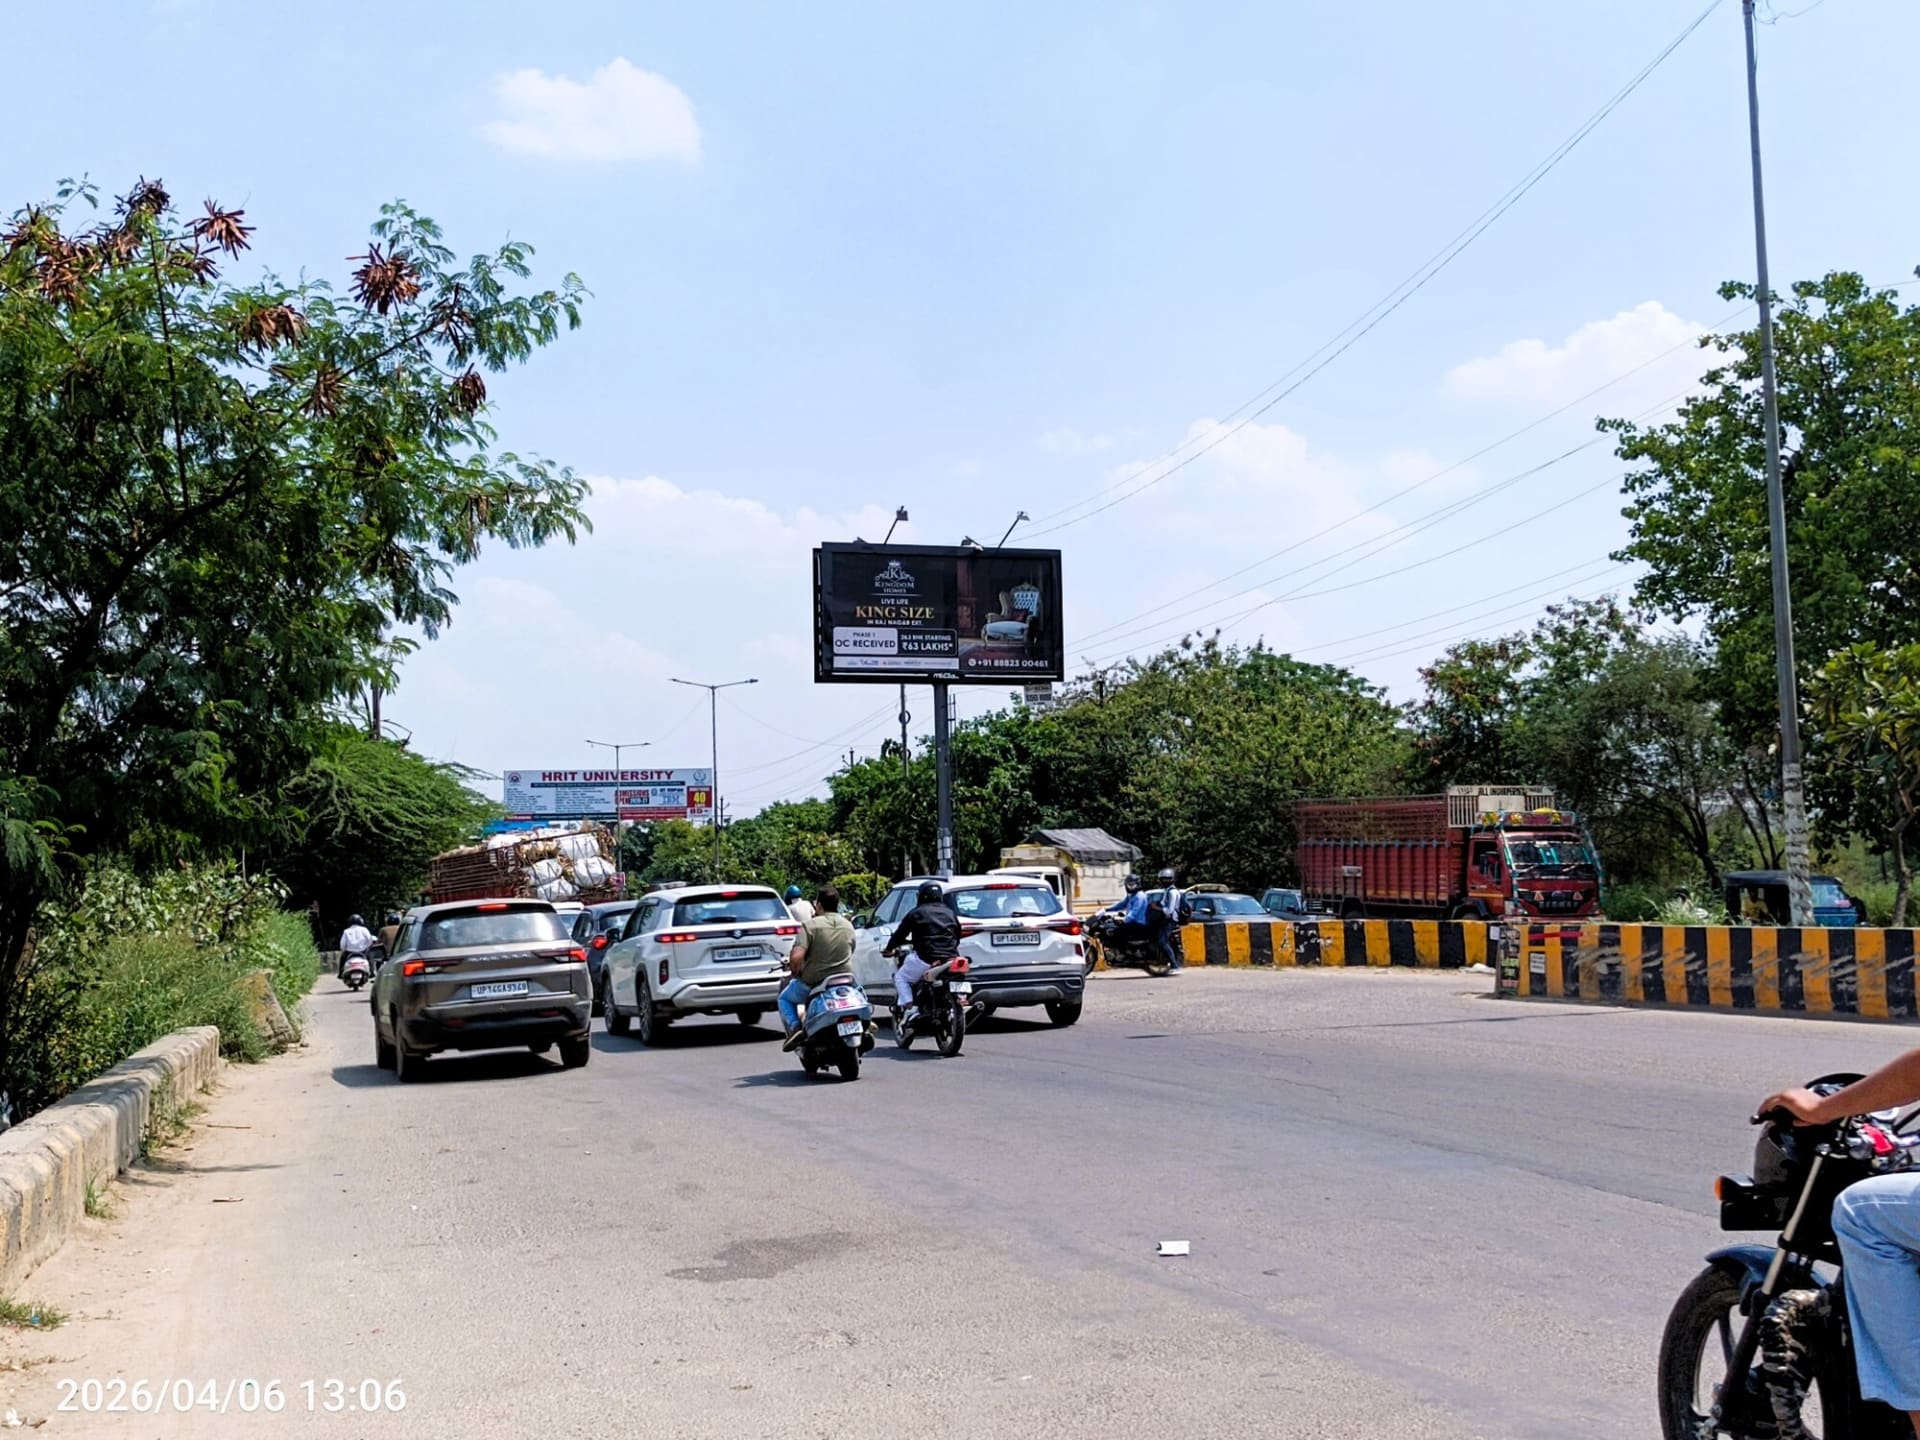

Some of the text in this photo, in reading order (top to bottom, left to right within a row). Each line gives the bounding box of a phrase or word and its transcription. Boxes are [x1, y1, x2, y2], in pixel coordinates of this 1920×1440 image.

[874, 581, 915, 589] KINGDOM
[855, 606, 935, 619] KING SIZE
[834, 639, 896, 648] OC RECEIVED
[541, 770, 674, 782] HRIT UNIVERSITY
[693, 791, 706, 803] 40
